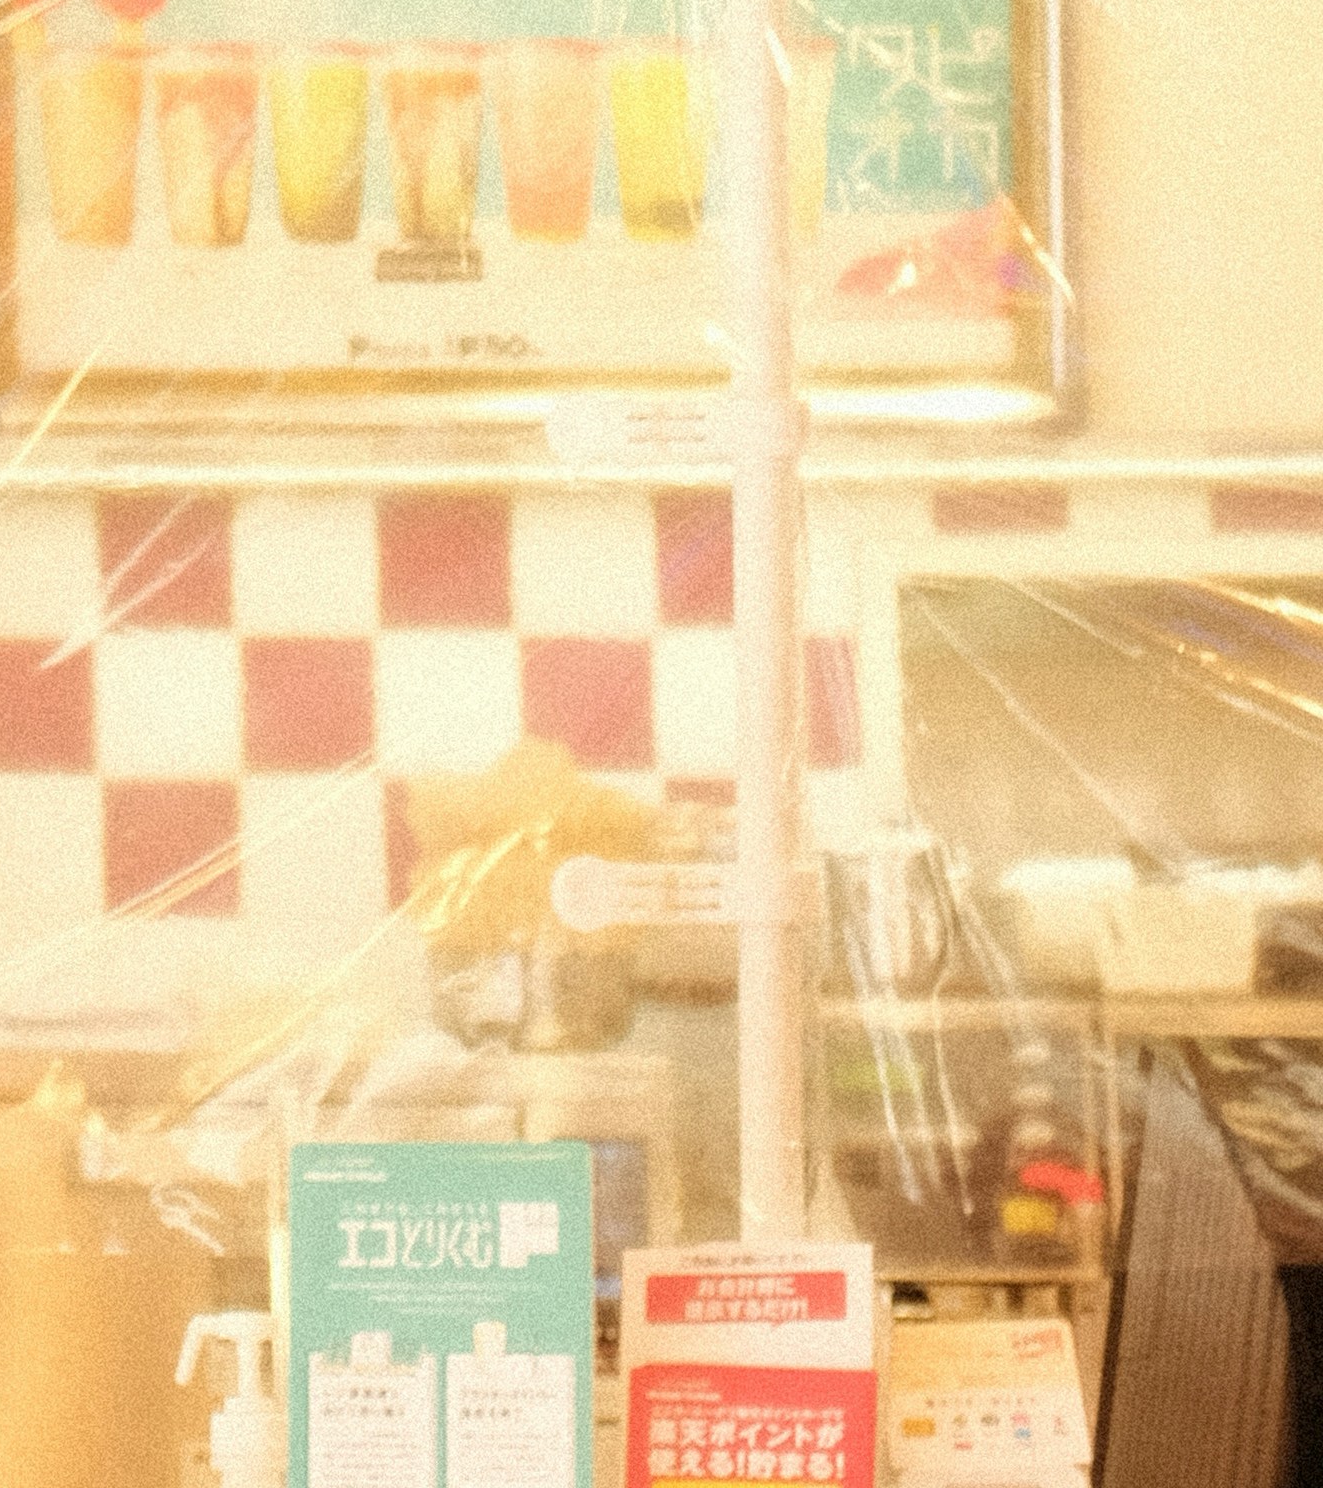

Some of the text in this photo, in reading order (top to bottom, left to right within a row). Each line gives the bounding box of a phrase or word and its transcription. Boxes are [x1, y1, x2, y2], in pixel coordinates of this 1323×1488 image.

[649, 1417, 845, 1449] 楽天ポイントが
